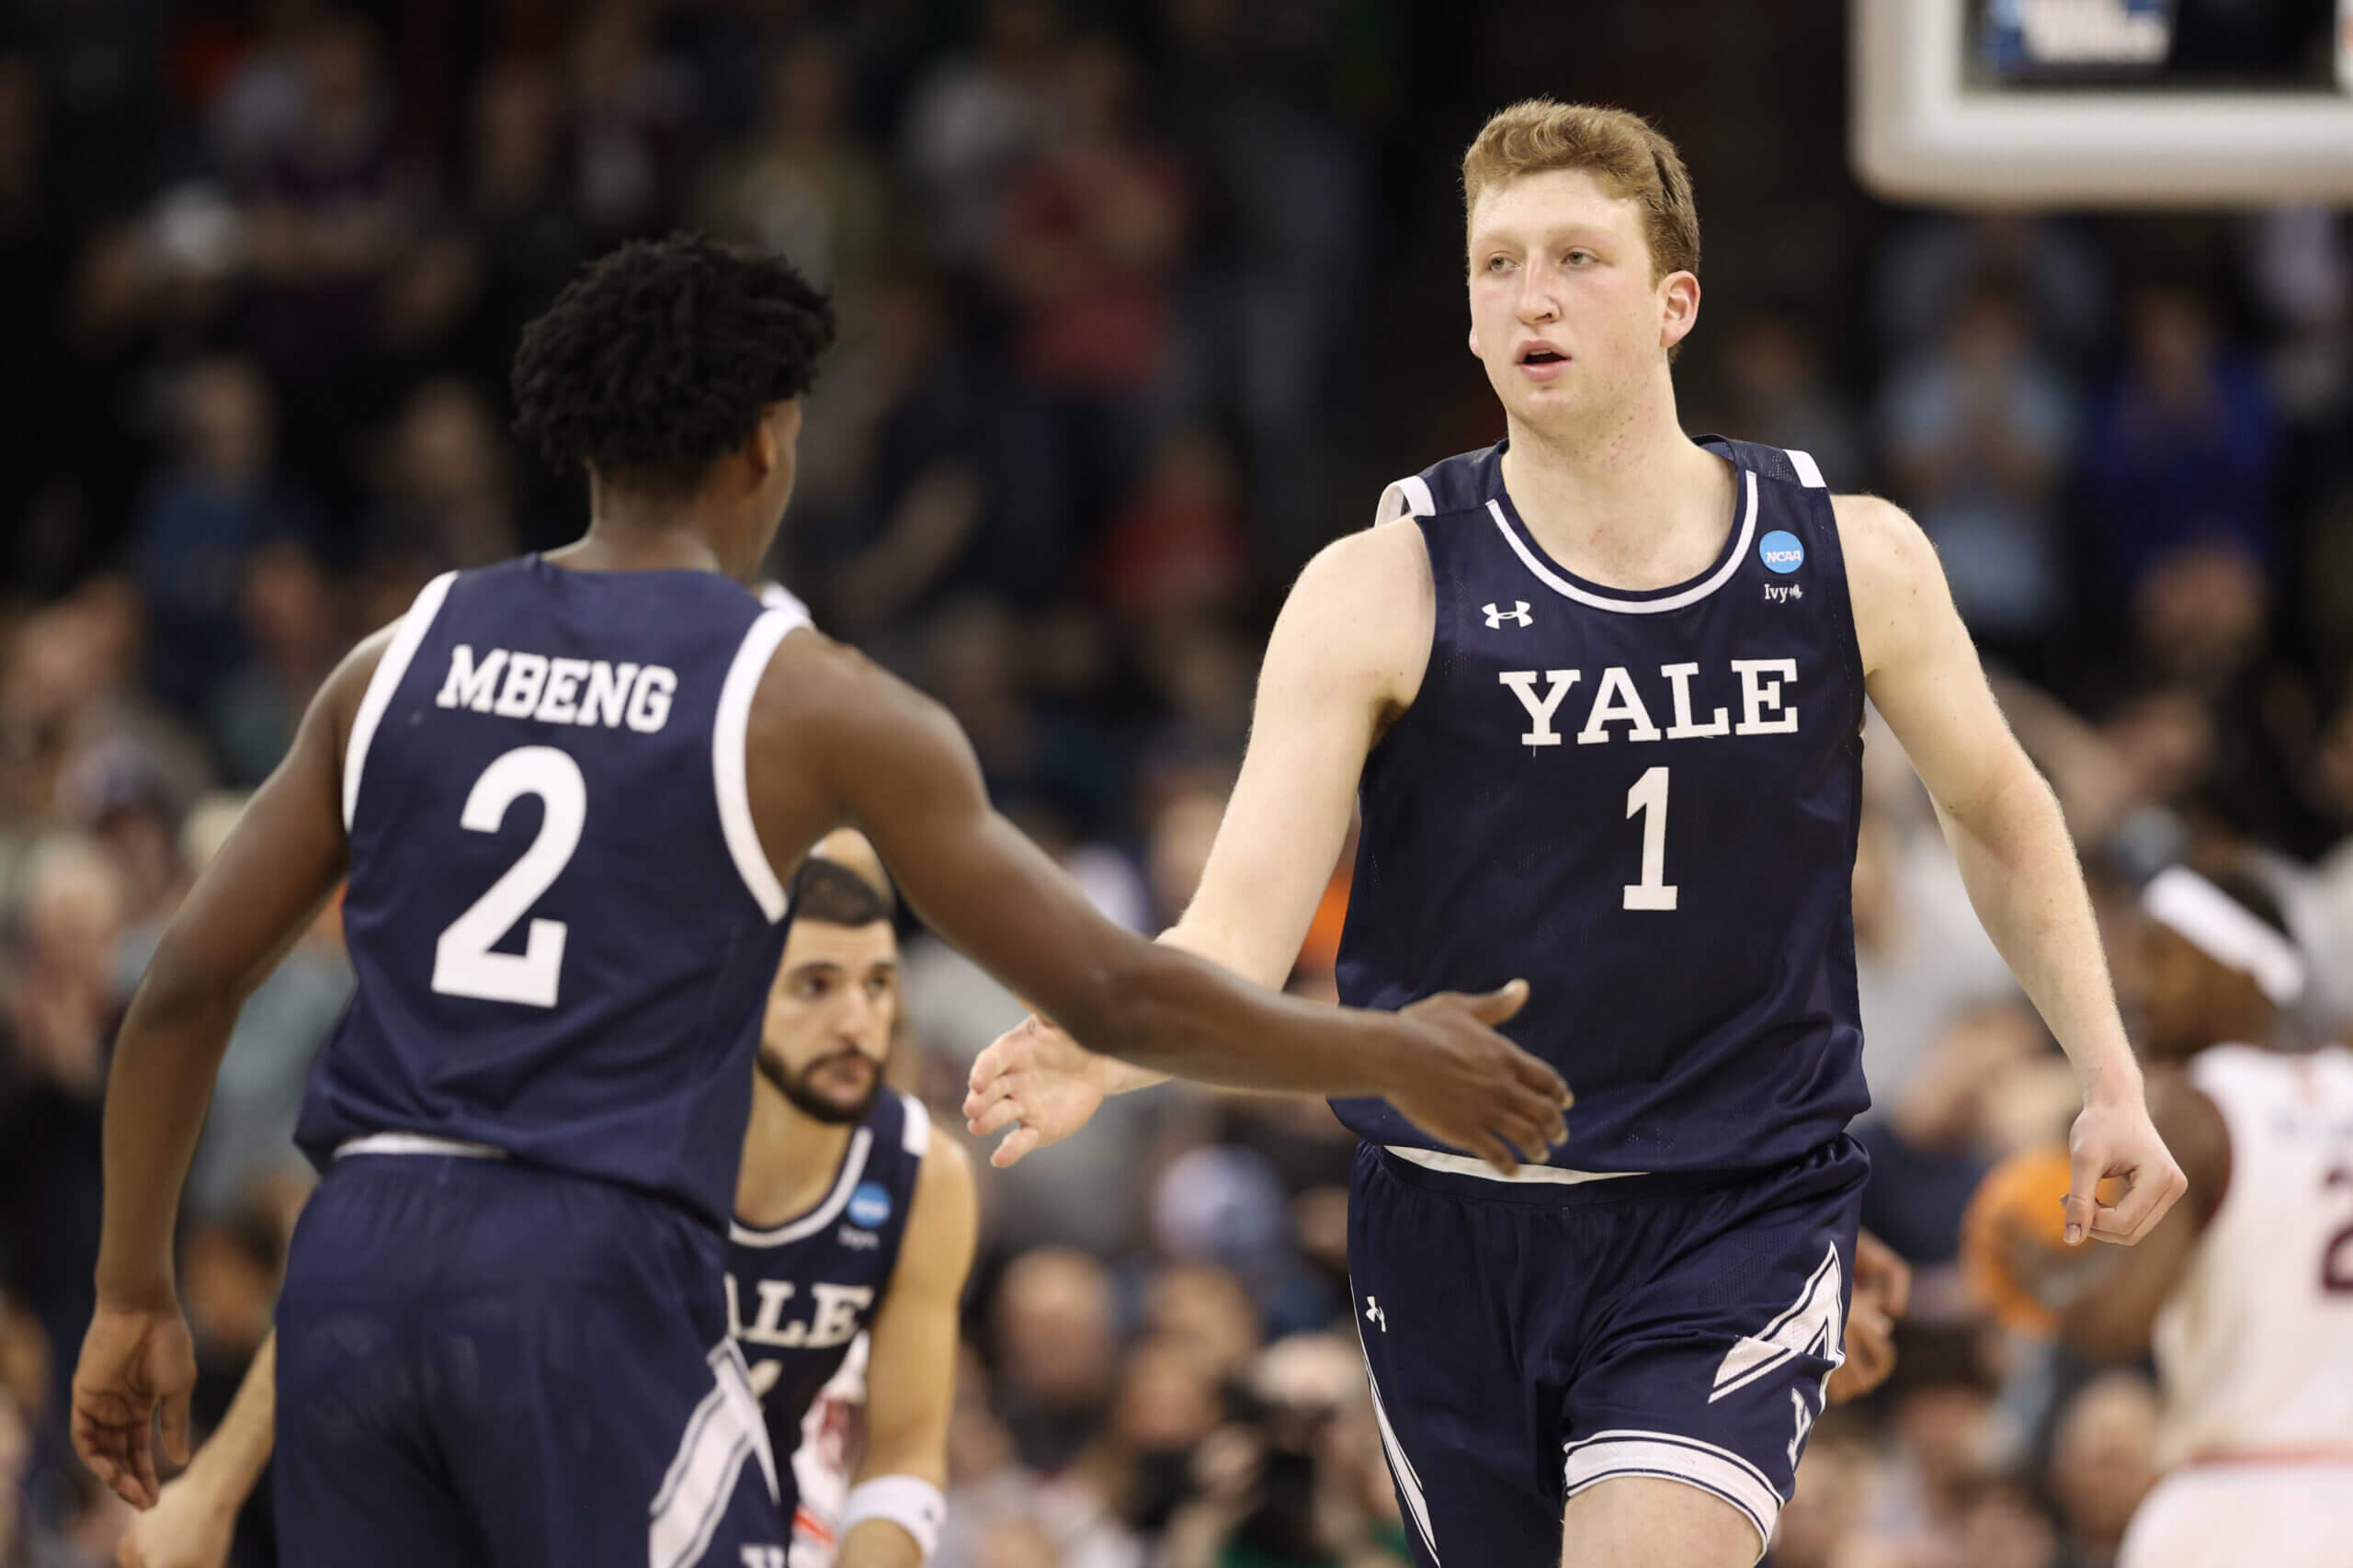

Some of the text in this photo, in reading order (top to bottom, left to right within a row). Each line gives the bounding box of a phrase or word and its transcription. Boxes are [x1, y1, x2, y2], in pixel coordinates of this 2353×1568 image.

[1764, 583, 1789, 603] Ivy
[1767, 550, 1802, 562] NCAA
[436, 644, 677, 733] MBENG
[1499, 658, 1799, 745] YALE
[432, 745, 586, 1008] 2
[1623, 767, 1678, 911] 1
